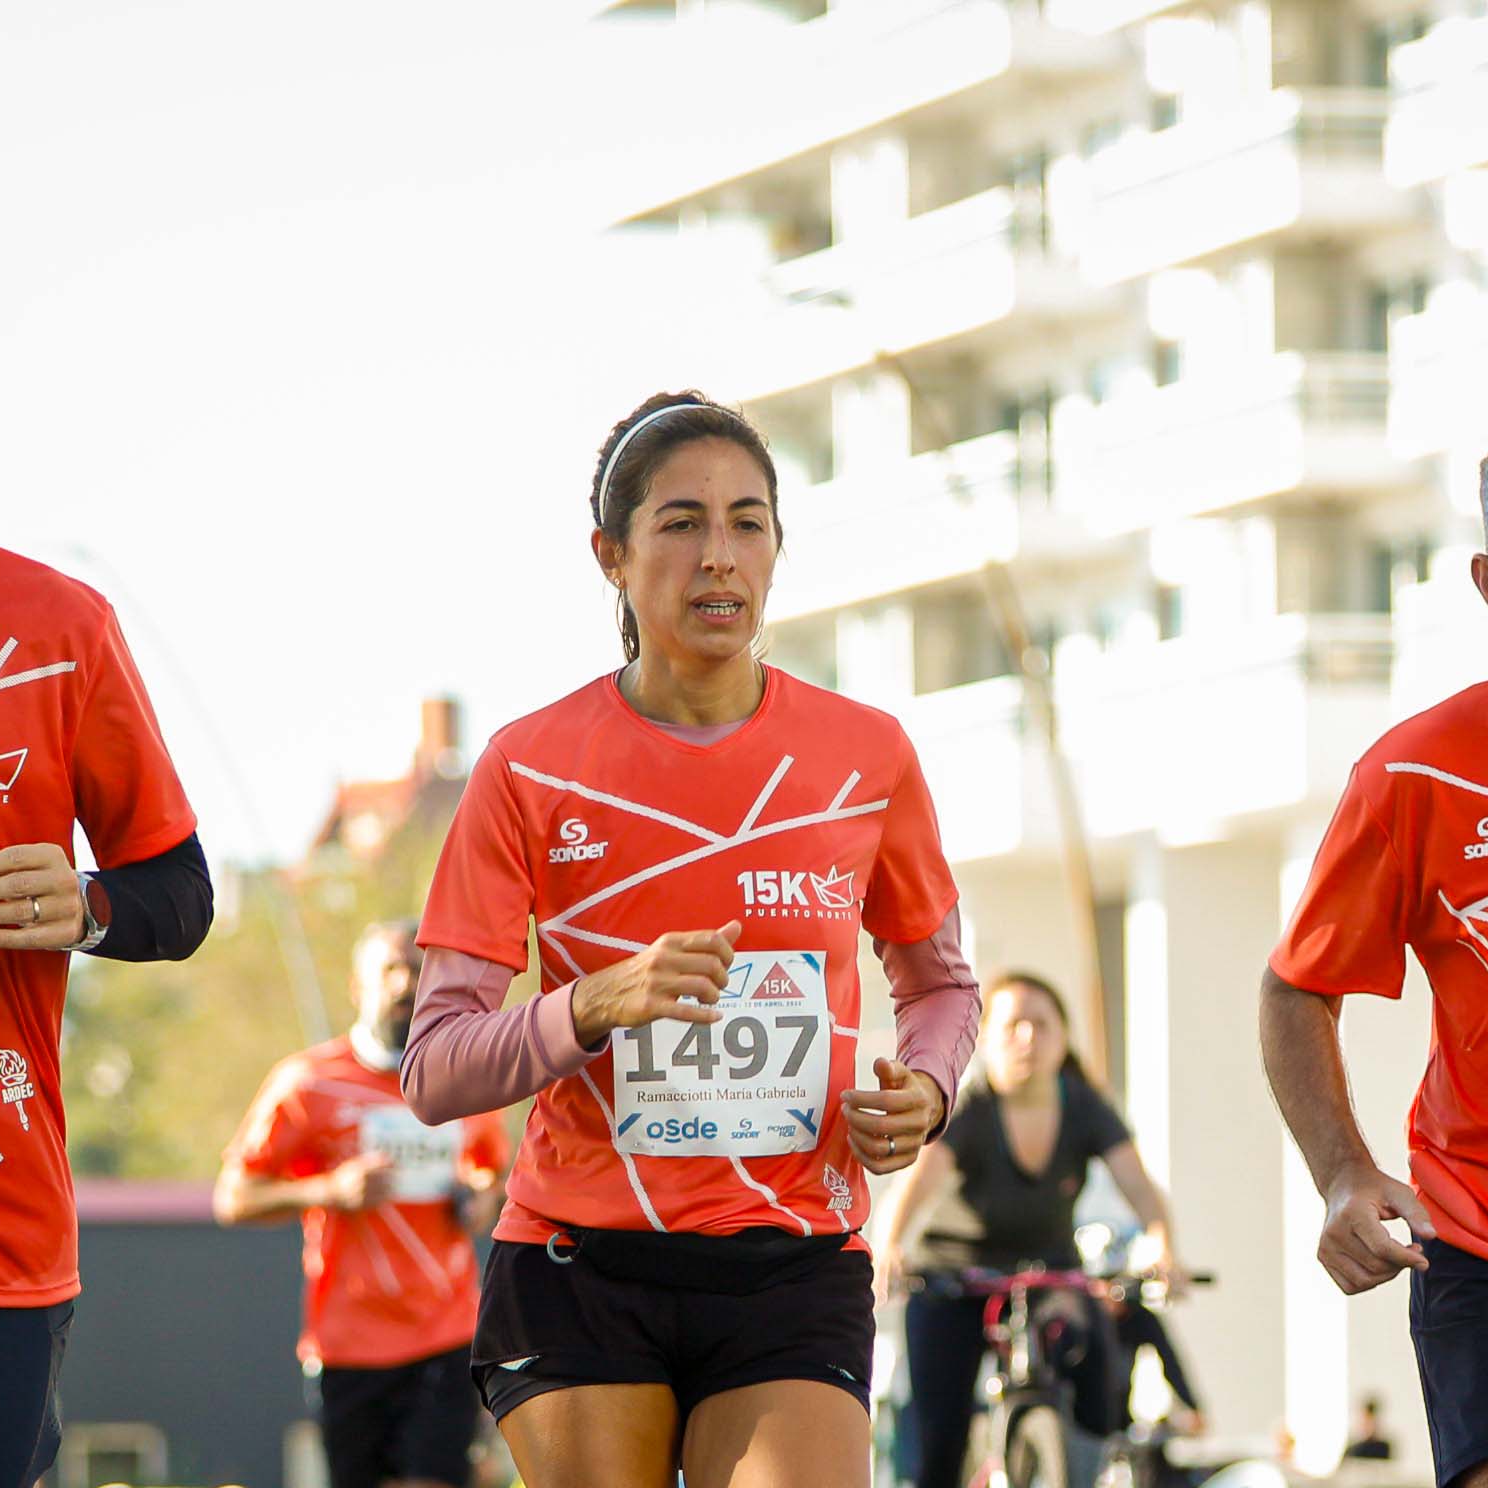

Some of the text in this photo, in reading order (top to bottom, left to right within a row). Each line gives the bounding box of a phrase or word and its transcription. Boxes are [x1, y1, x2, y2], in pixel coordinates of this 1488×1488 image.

[737, 870, 810, 906] 15K
[745, 908, 811, 918] PUERTO
[763, 979, 793, 994] 15K
[624, 1015, 819, 1083] 1497
[1, 1082, 35, 1105] ARDEC
[637, 1089, 712, 1103] Ramacciotti
[756, 1086, 807, 1099] Gabriela
[646, 1115, 718, 1142] osde
[826, 1196, 853, 1211] ARDEC
